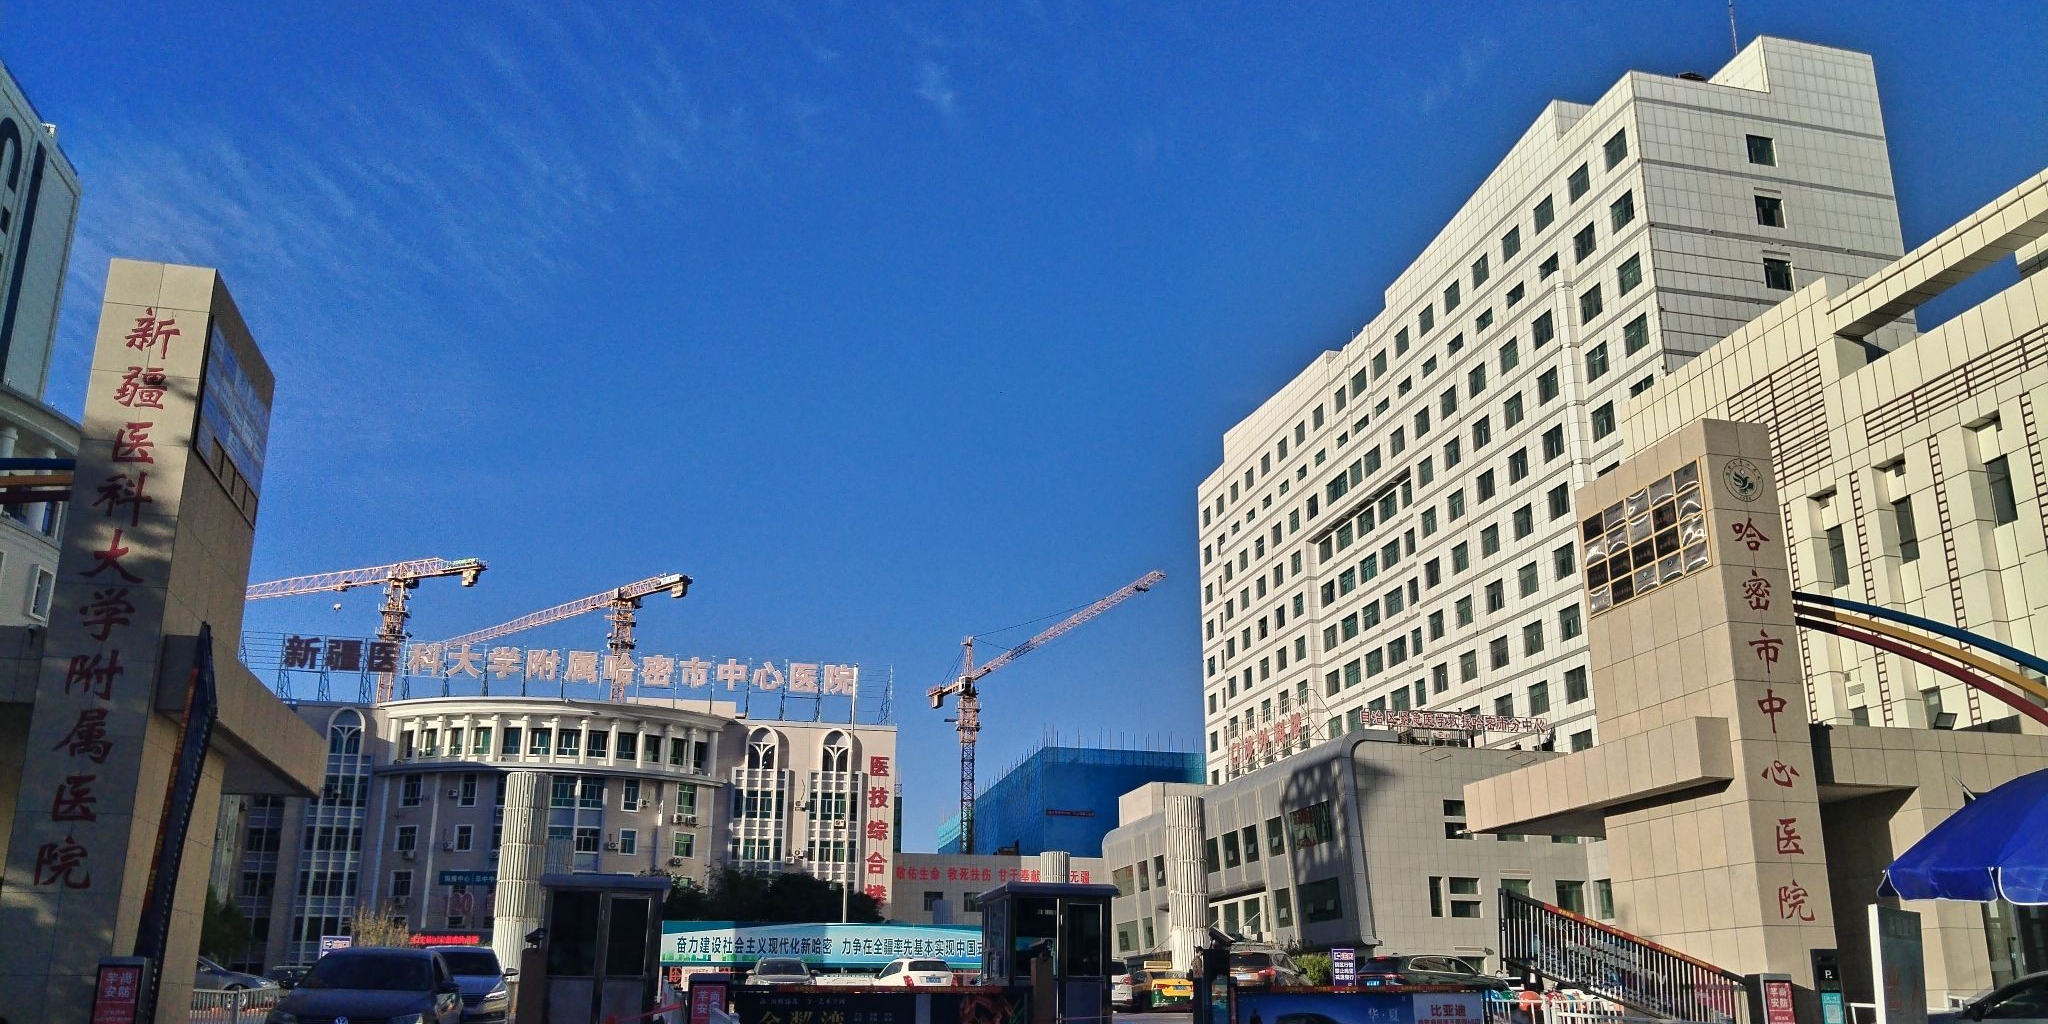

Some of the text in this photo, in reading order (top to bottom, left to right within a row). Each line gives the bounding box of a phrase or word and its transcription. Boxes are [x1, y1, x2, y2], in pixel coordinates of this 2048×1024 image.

[33, 307, 181, 889] 新疆医科大学附属医院
[284, 634, 858, 695] 新疆医科大学附属哈密市中心医院
[1360, 709, 1547, 733] 自治区紧急医学救援哈密市分中心
[1731, 517, 1816, 922] 哈密市中心医院
[864, 755, 890, 906] 医技综合楼
[896, 866, 941, 881] 敬佑生命
[947, 867, 992, 881] 救死扶伤
[998, 868, 1041, 883] 甘于奉献
[676, 935, 833, 956] 奋力建设社会主义现代化新哈密
[104, 986, 131, 998] 安防
[1430, 1004, 1467, 1017] 比亚迪
